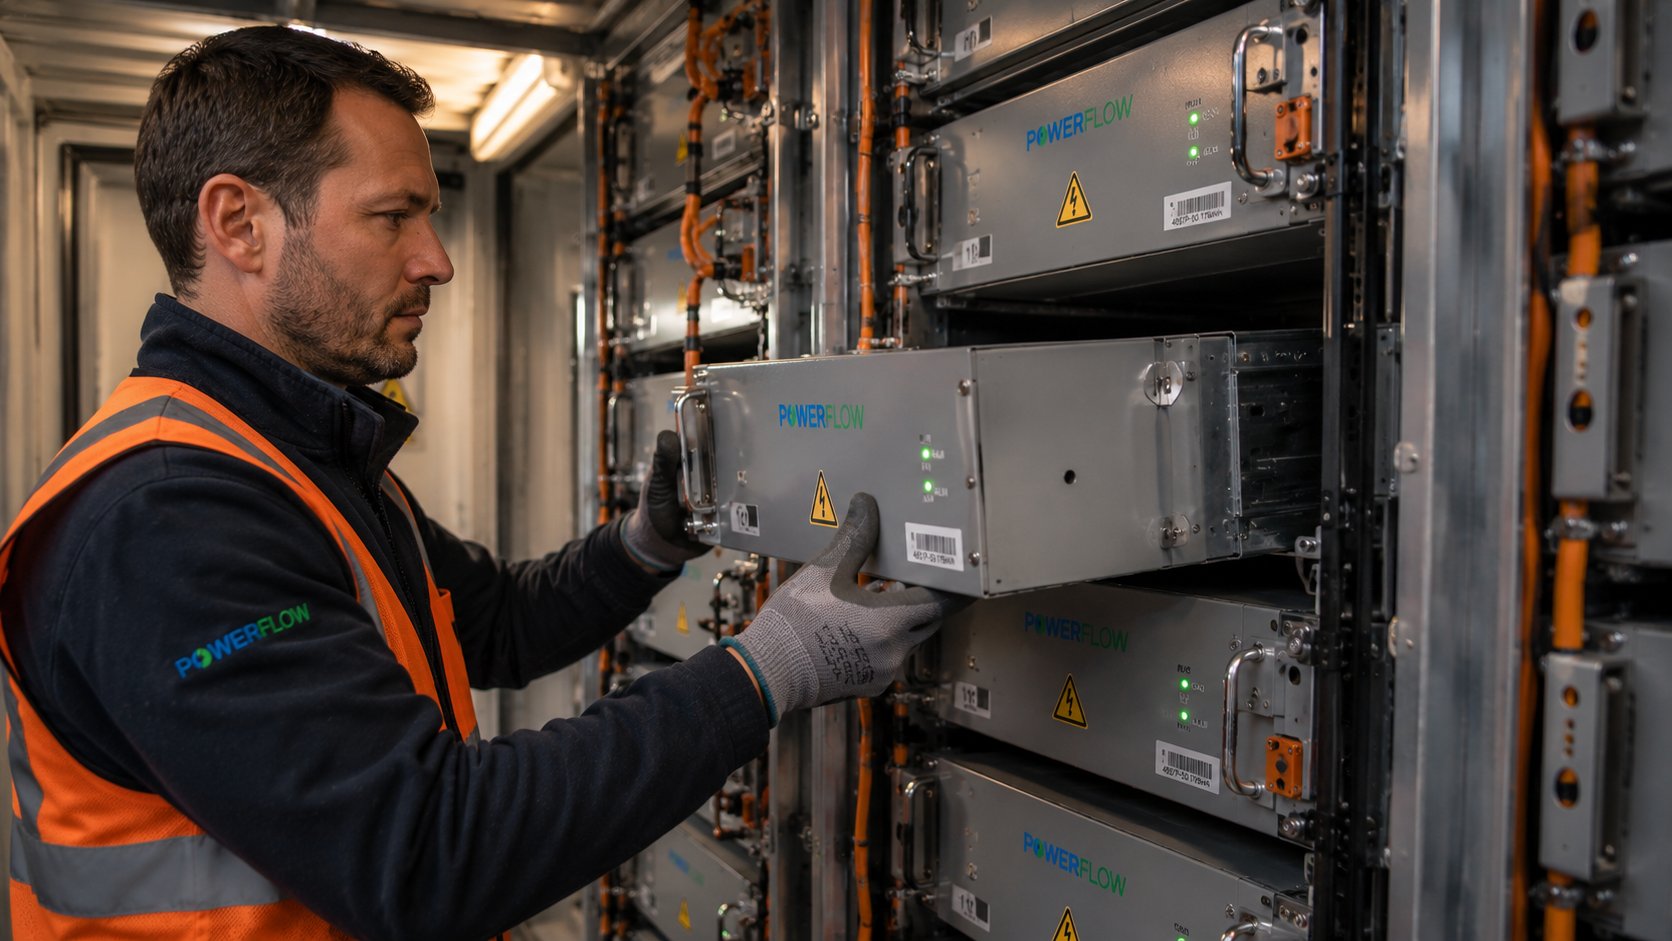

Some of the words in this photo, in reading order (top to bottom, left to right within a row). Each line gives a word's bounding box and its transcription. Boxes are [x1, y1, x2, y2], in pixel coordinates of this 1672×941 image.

[1026, 94, 1134, 152] POWERFLOW
[778, 403, 865, 429] POWERFLOW
[174, 602, 311, 679] POWERFLOW
[1024, 610, 1129, 653] POWERFLOW
[1023, 831, 1127, 897] POWERFLOW
